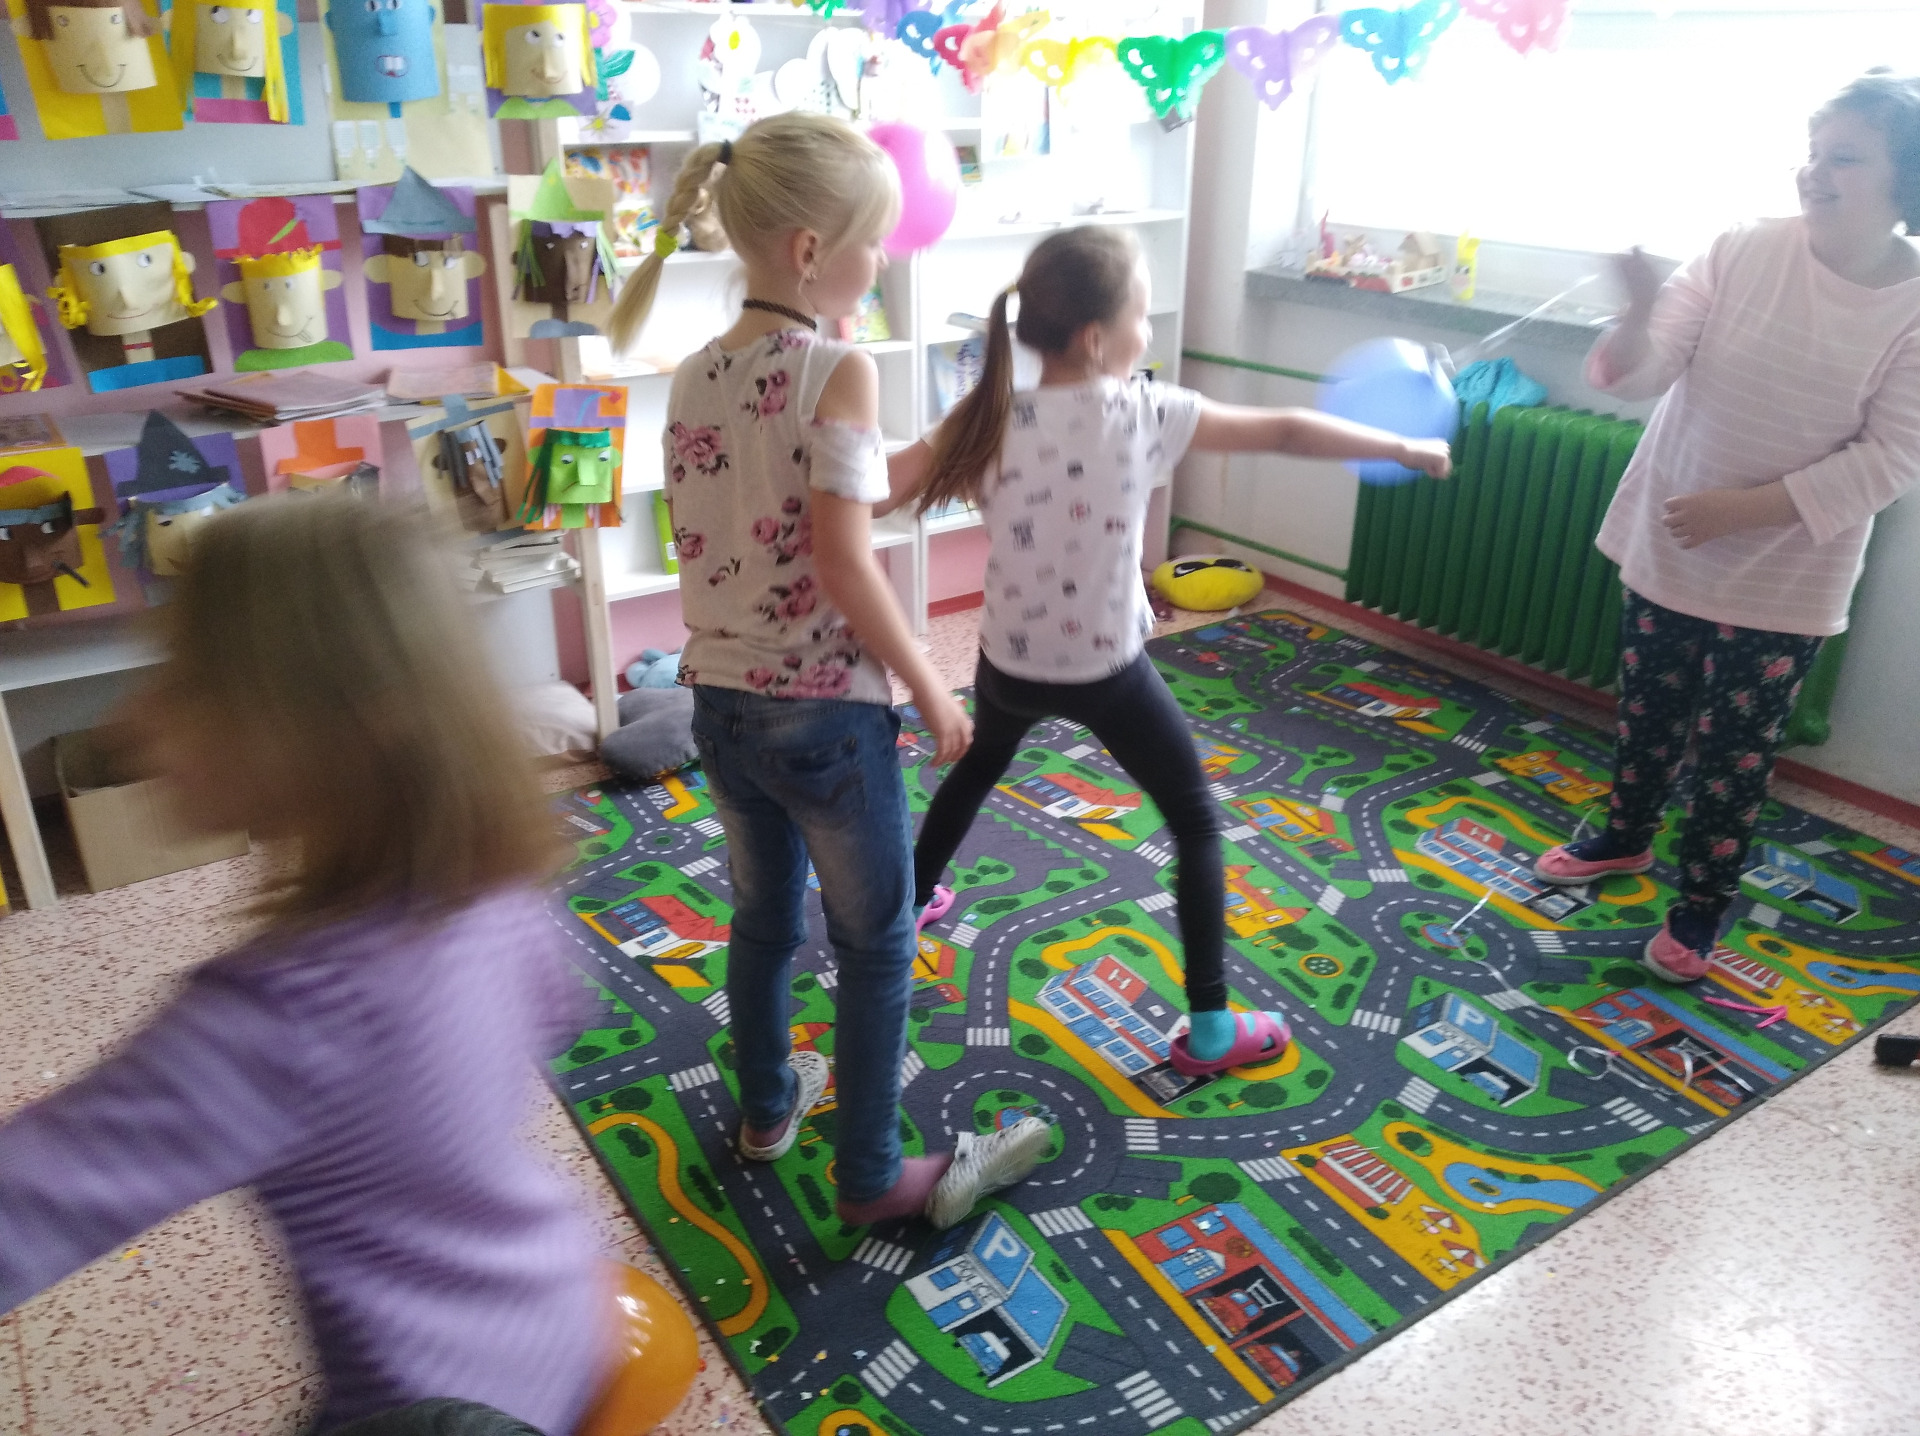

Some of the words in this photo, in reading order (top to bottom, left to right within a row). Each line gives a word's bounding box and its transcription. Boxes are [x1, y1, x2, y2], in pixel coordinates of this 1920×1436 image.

[1108, 968, 1133, 990] H
[1455, 1003, 1486, 1027] P
[983, 1226, 1021, 1261] P
[951, 1259, 1001, 1304] POLICE
